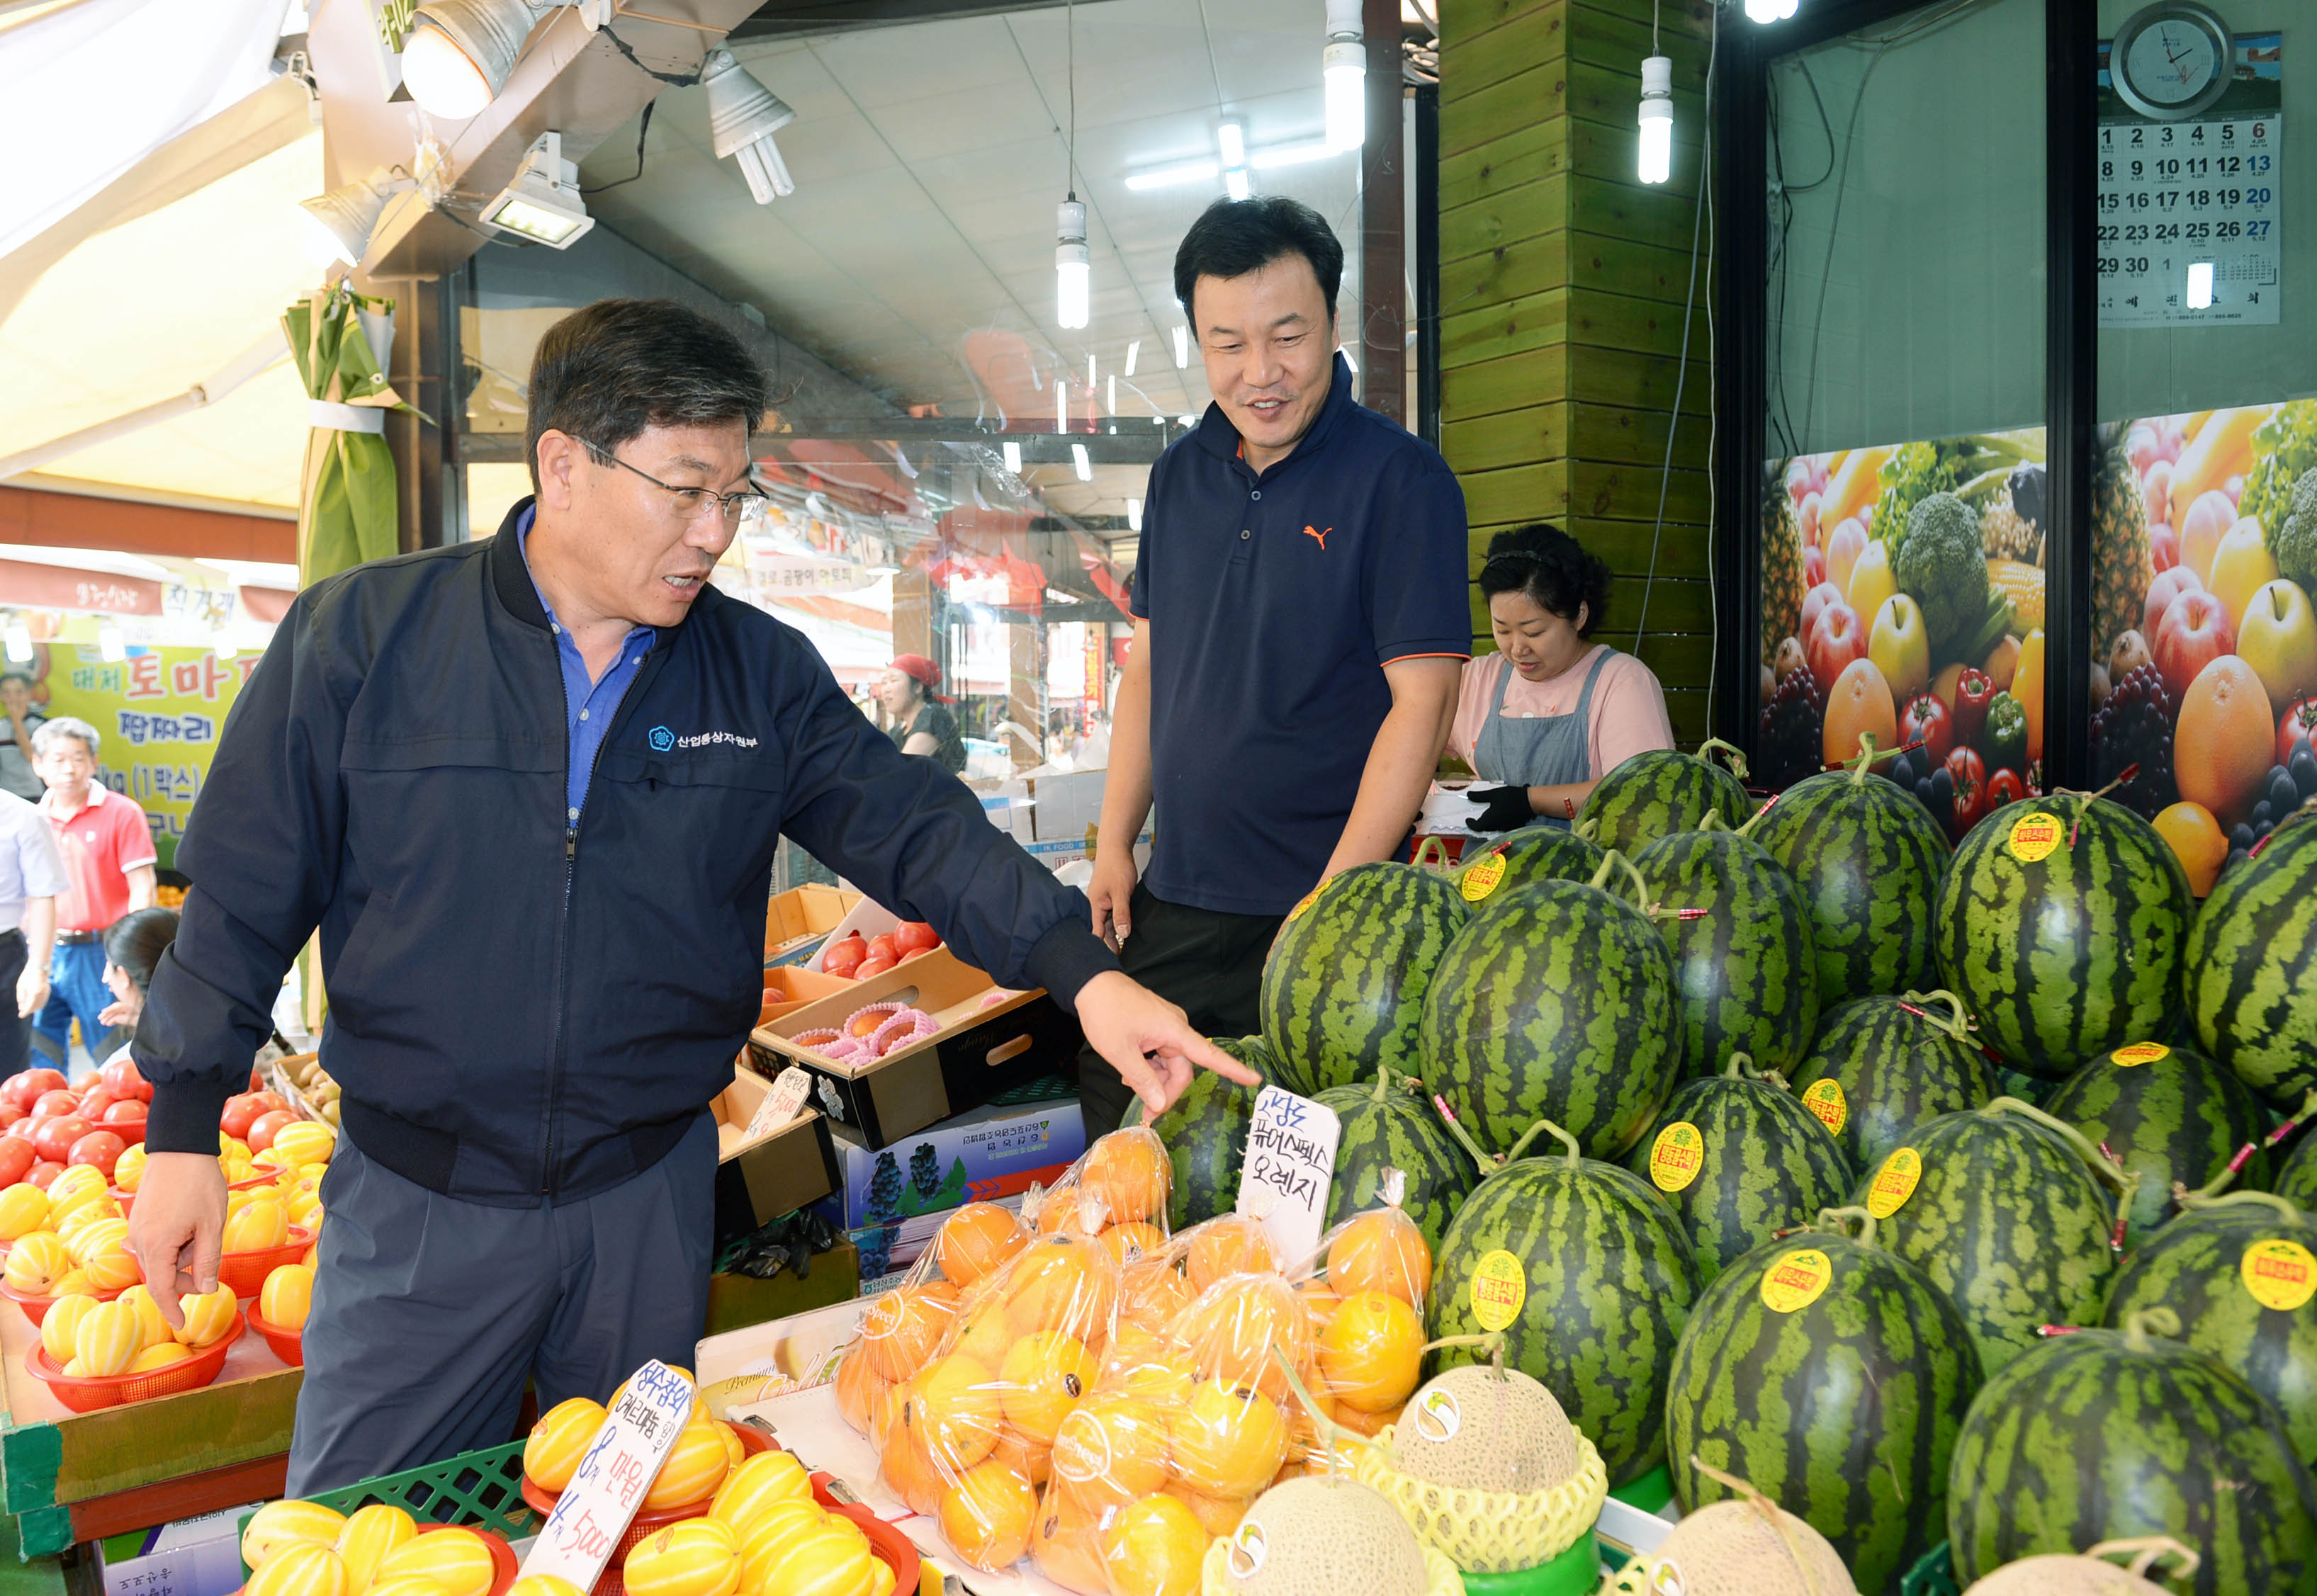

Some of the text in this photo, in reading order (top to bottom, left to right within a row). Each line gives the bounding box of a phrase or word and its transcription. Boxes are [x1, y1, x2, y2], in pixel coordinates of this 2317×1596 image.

[2102, 123, 2265, 144] 1 2 3 4 5 6
[2102, 155, 2270, 176] 8 9 10 11 12 13
[2097, 188, 2271, 208] 15 16 17 18 19 20
[2097, 220, 2271, 240] 22 23 24 25 26 27
[2097, 257, 2170, 273] 29 30 1
[72, 665, 122, 694] 대저
[119, 711, 213, 742] 짭짜리
[677, 731, 759, 748] 산업통상자원부
[1253, 1154, 1317, 1212] 오렌지
[637, 1362, 689, 1417] 성주참외
[724, 1363, 776, 1395] Premium
[606, 1450, 643, 1510] 만원
[119, 1568, 172, 1590] 송산포도
